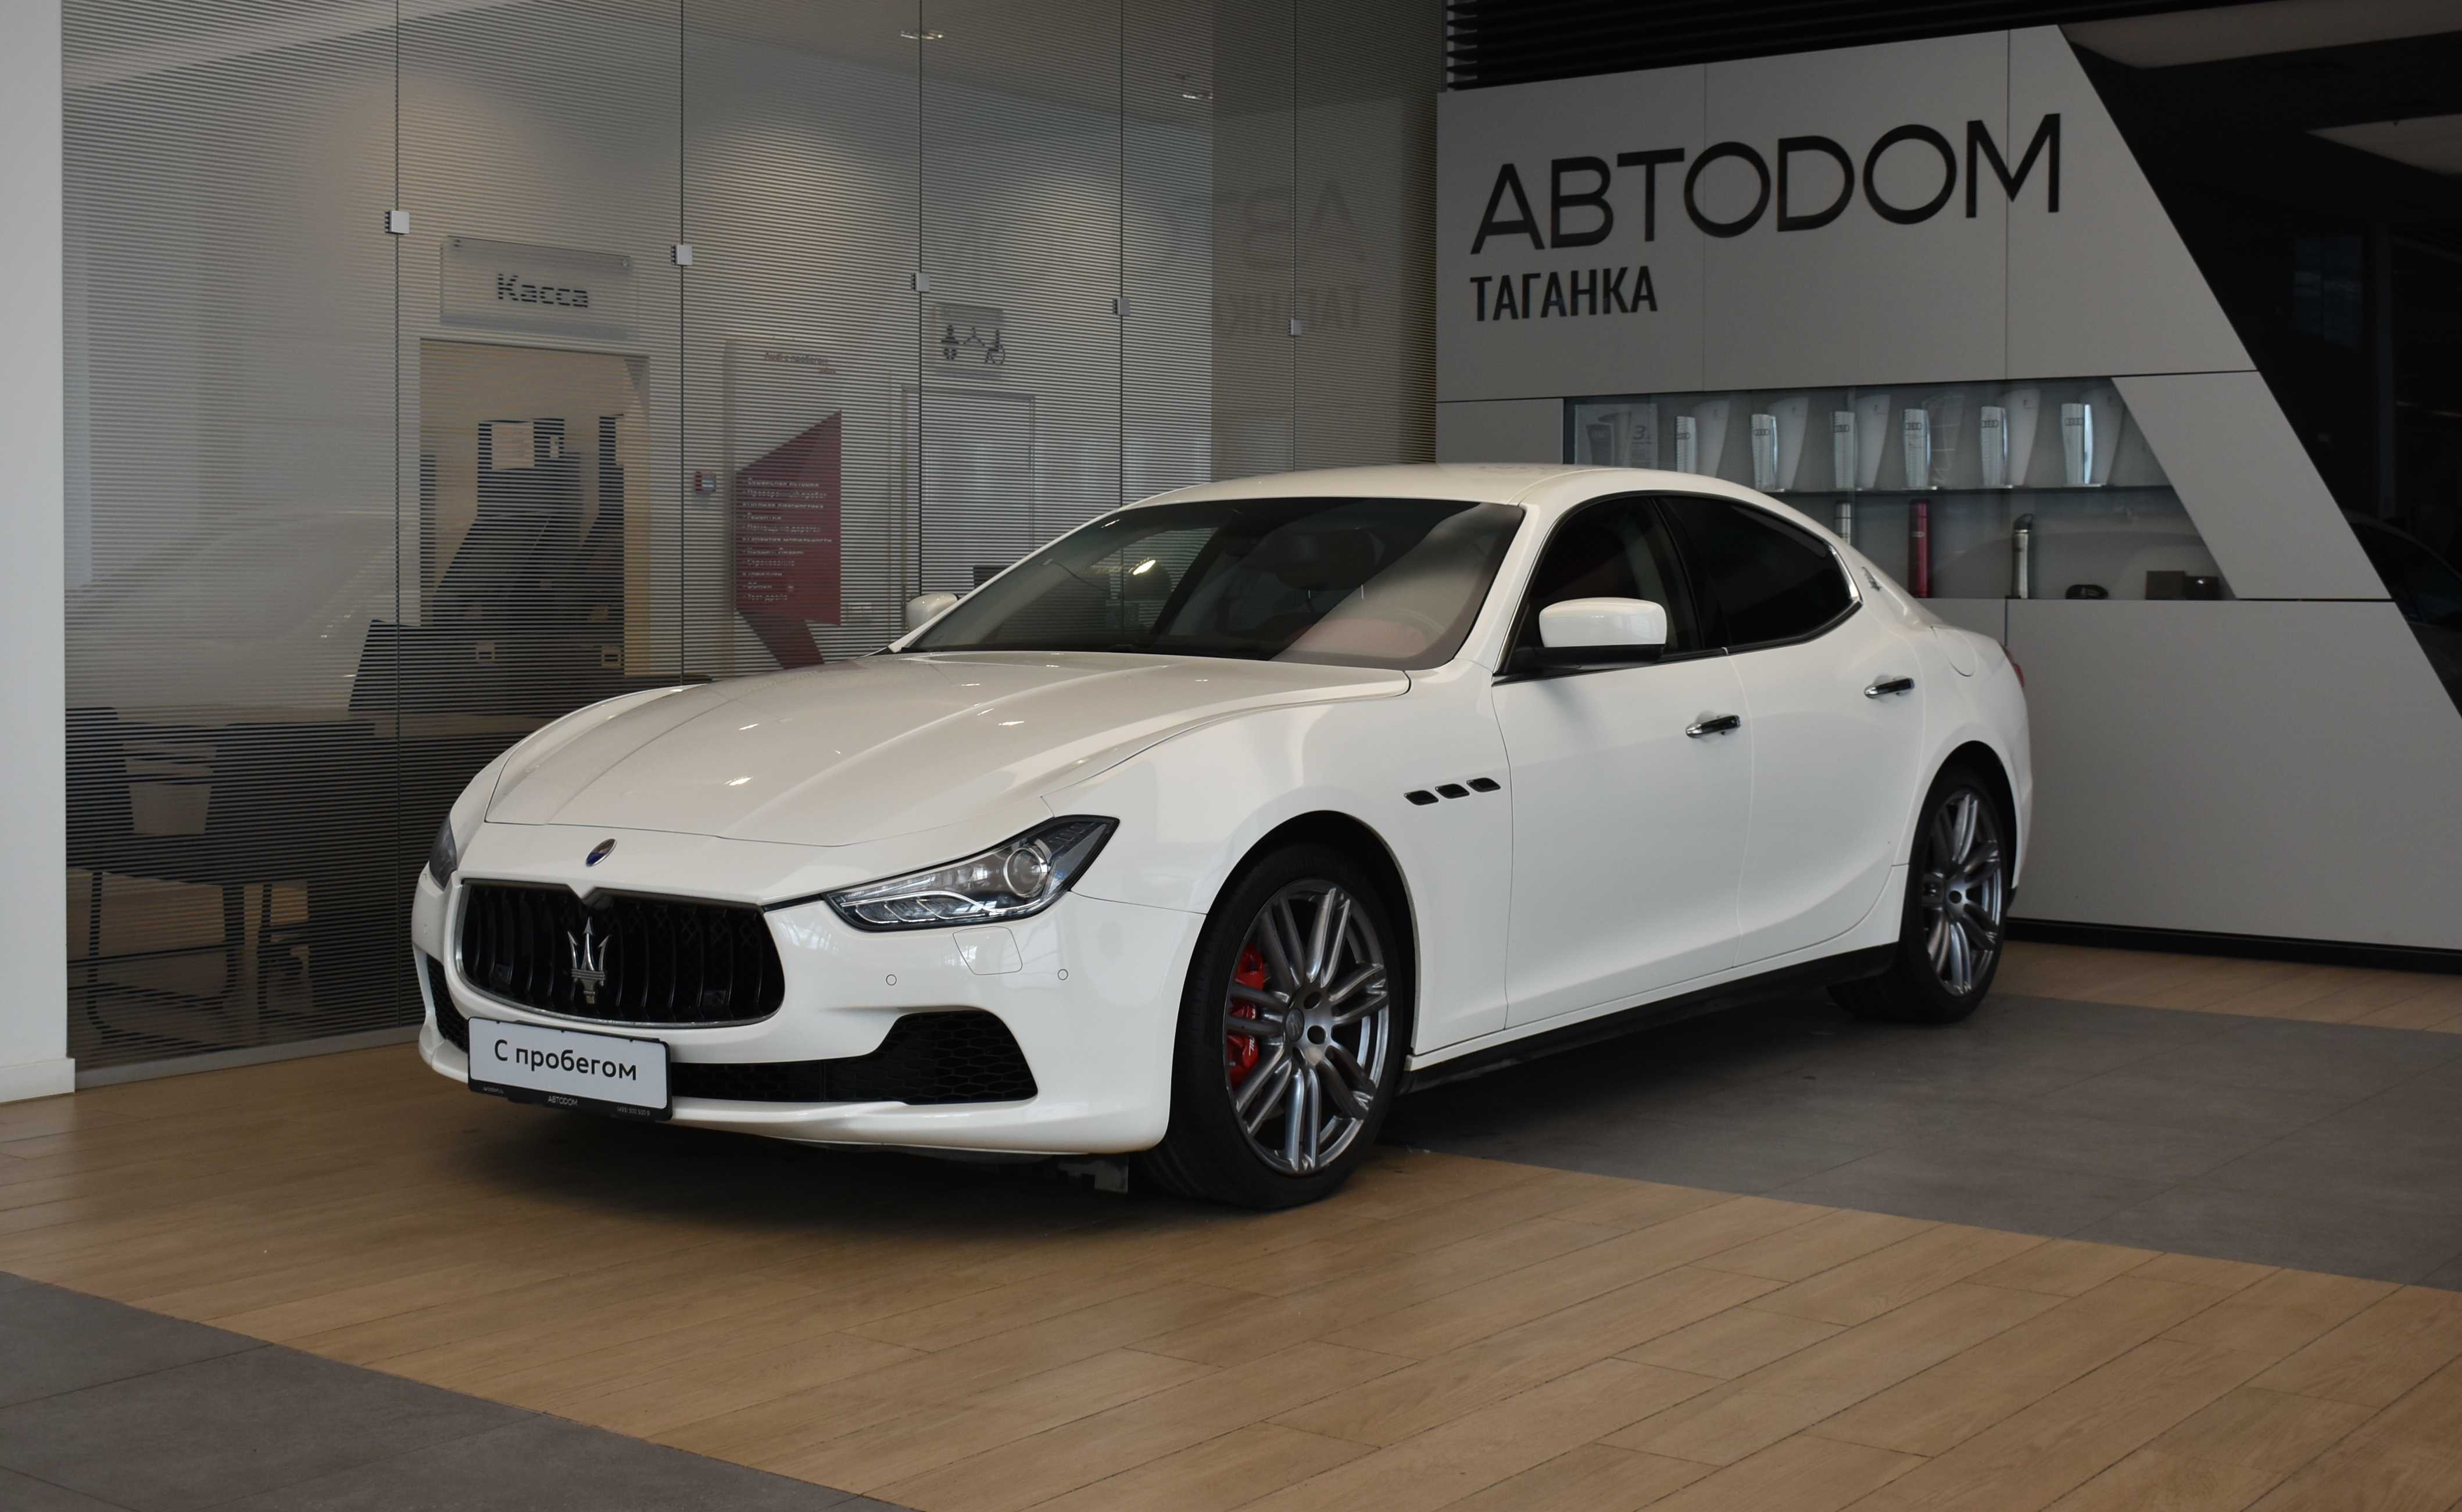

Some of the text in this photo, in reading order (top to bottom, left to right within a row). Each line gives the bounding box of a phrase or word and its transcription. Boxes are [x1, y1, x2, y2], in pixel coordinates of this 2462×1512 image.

[498, 273, 589, 308] Касса
[1469, 265, 1658, 322] ТАГАНКА
[495, 1039, 637, 1081] С пробегом
